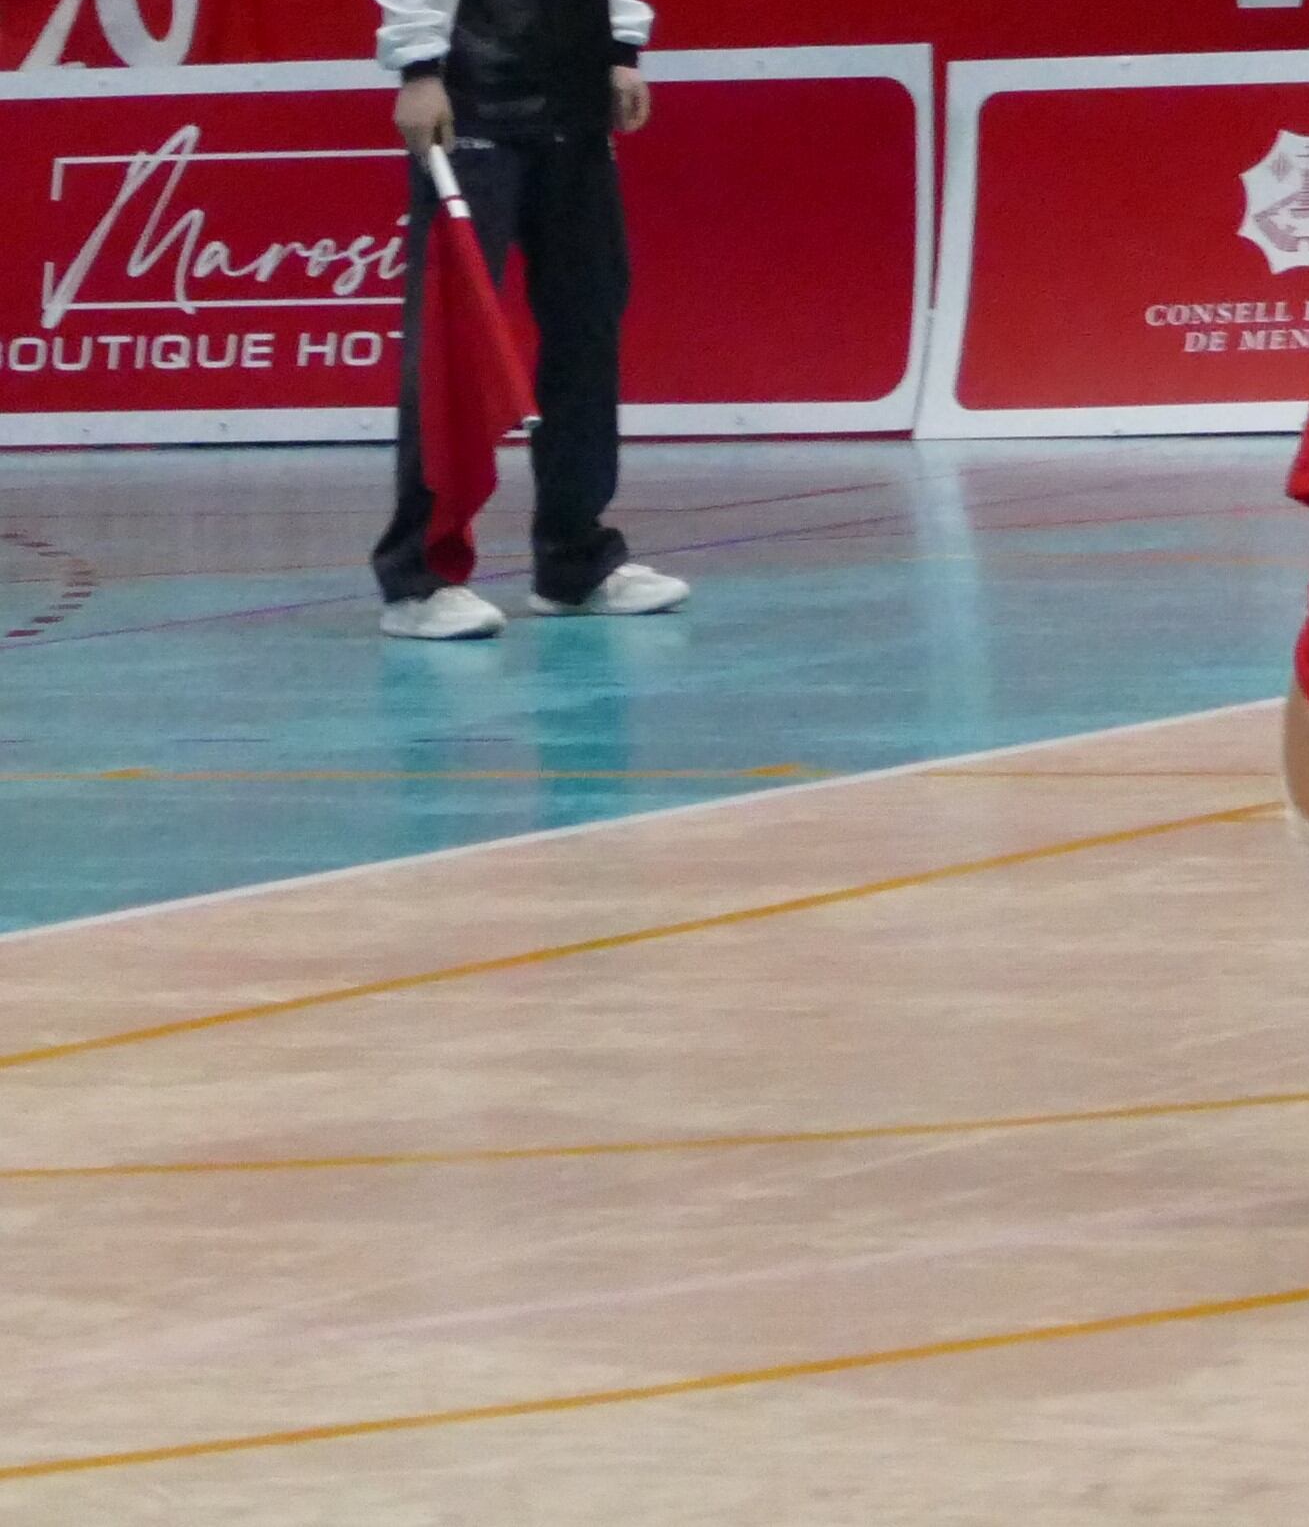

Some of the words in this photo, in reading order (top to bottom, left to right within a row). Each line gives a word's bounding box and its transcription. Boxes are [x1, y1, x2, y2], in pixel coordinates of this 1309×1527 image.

[1145, 301, 1294, 326] CONSELL
[0, 334, 275, 371] OUTIQUE
[299, 331, 406, 367] HO
[1183, 331, 1229, 353] DE
